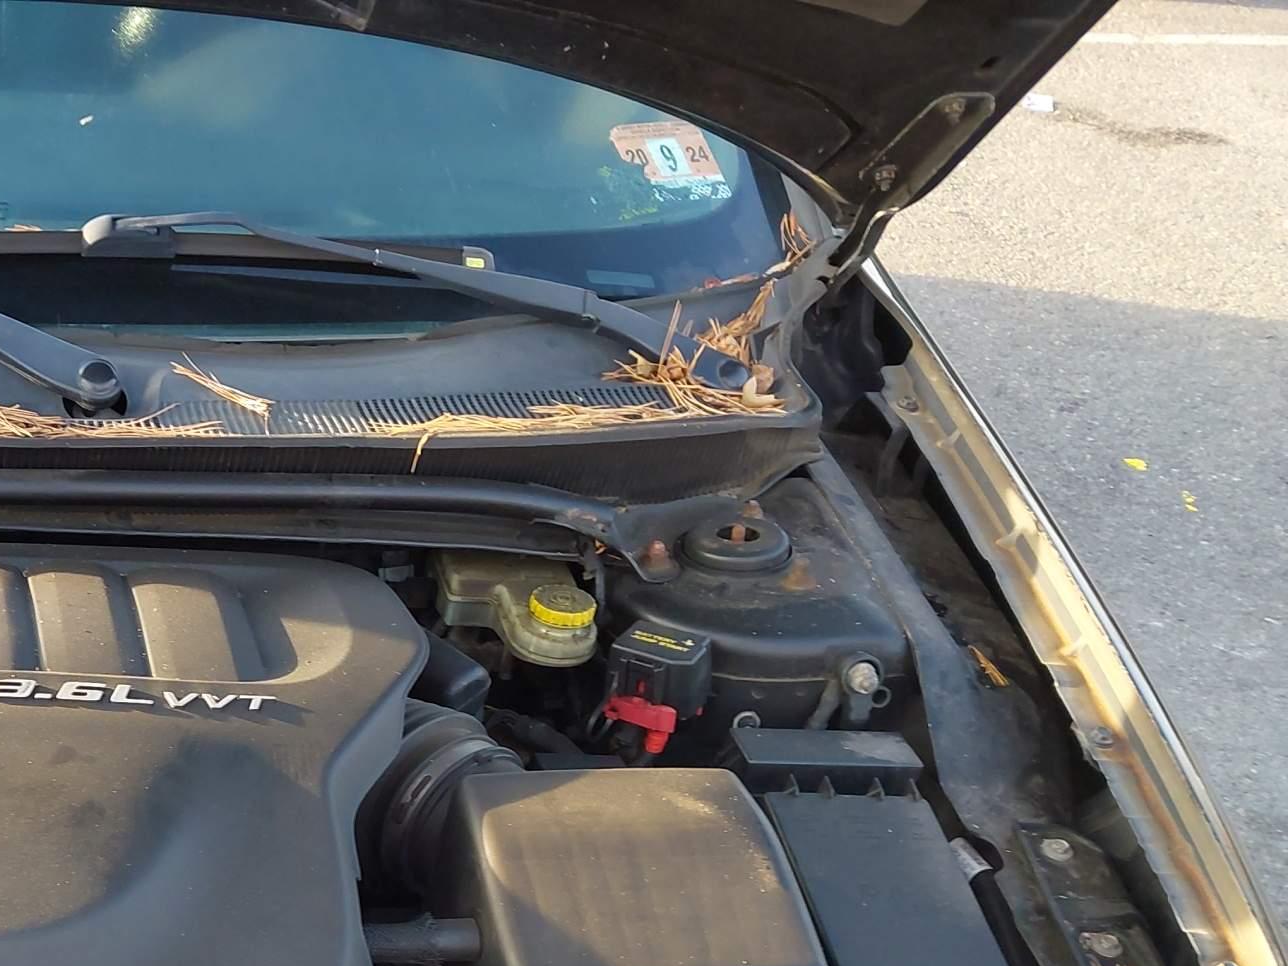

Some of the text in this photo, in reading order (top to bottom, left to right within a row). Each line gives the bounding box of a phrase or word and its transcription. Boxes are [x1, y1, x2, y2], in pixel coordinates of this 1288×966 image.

[625, 144, 710, 172] 20 9 24
[163, 691, 277, 711] VVT
